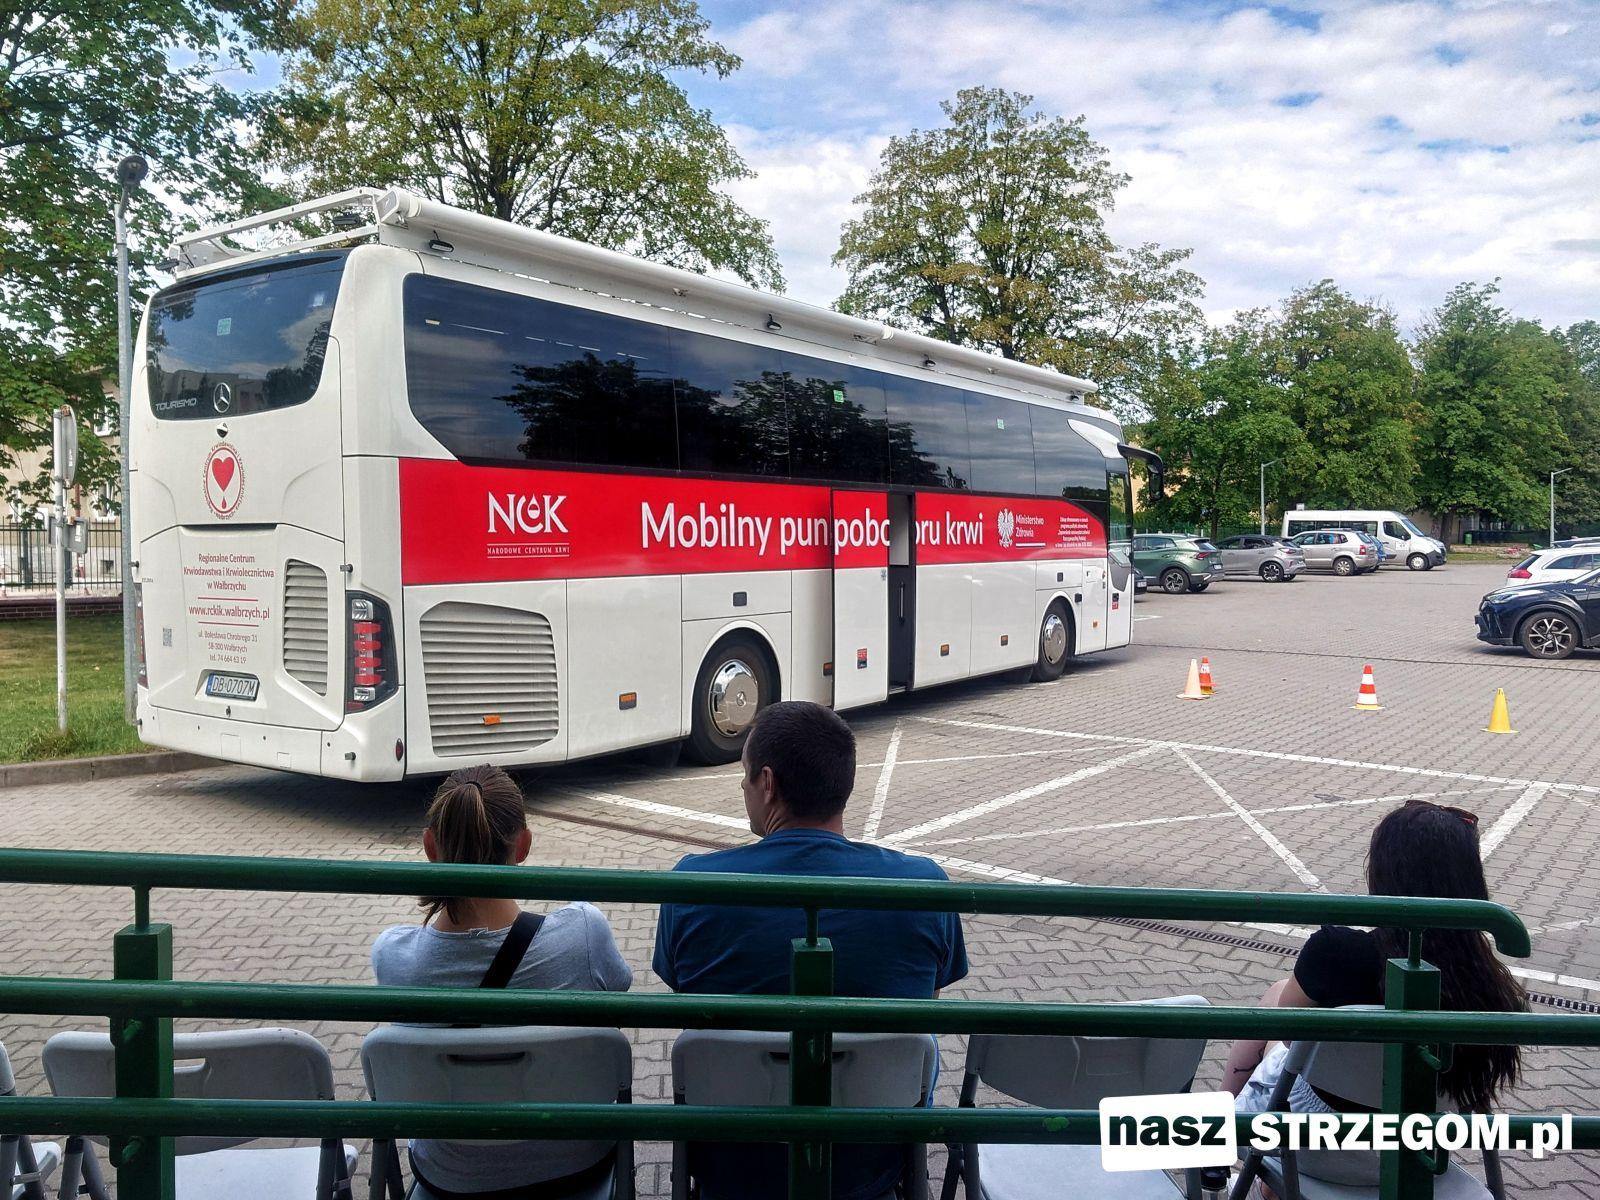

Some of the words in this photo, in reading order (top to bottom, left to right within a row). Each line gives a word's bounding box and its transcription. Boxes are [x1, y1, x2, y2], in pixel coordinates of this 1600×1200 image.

[156, 398, 197, 410] TOURISMO
[1015, 514, 1045, 525] Ministerstwo
[641, 501, 773, 556] Mobilny
[780, 516, 829, 556] pun
[946, 510, 984, 545] krwi
[1015, 526, 1034, 538] Zdrowia
[487, 547, 521, 555] NARODOWE
[199, 553, 228, 564] Regionalne
[230, 554, 255, 563] Centrum
[184, 567, 221, 576] Krwiodawstwa
[226, 568, 274, 577] Krwiolecznictwa
[189, 604, 270, 620] www.rckik.walbrzych.pl
[212, 677, 225, 692] DB
[226, 678, 256, 696] 0707M
